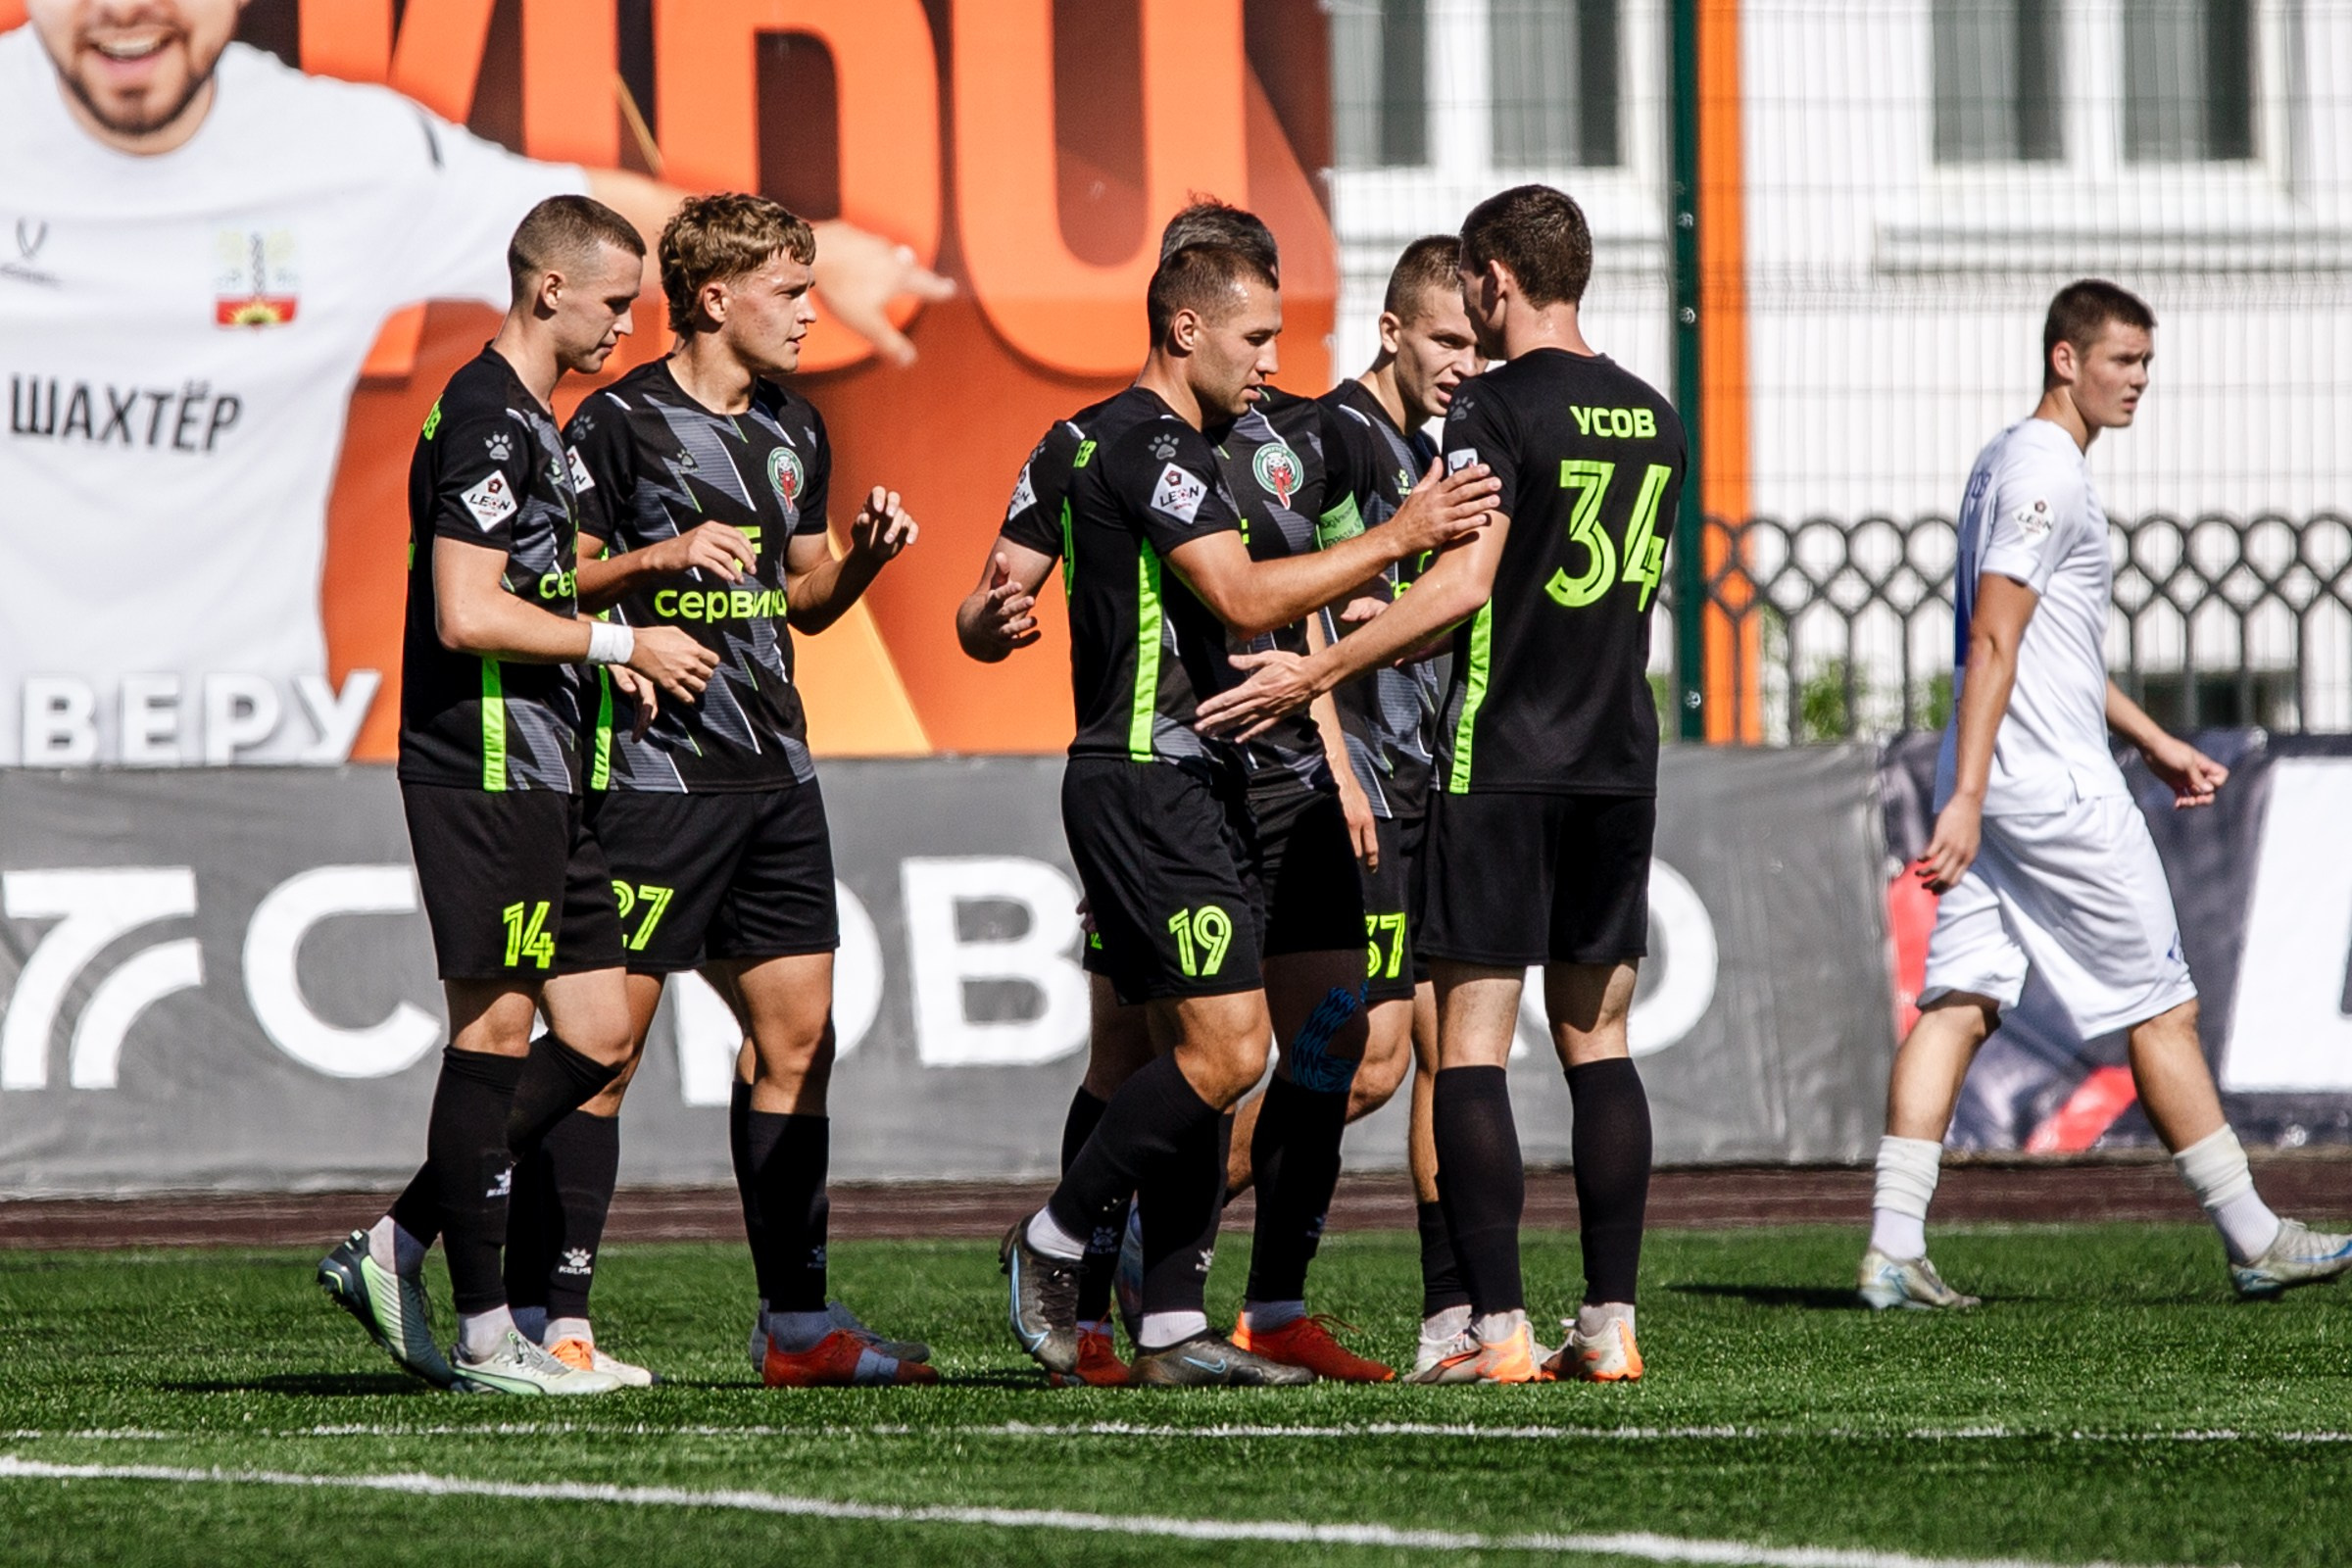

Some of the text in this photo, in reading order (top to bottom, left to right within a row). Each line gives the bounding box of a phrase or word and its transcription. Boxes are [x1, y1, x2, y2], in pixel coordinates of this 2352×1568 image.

[10, 370, 243, 451] ШАХТЁР
[1569, 404, 1658, 439] УСОВ
[468, 492, 511, 511] LEON
[1159, 484, 1200, 508] LEON
[1544, 459, 1674, 613] 34
[22, 668, 383, 767] ВЕРУ
[503, 901, 556, 969] 14
[1168, 905, 1233, 977] 19
